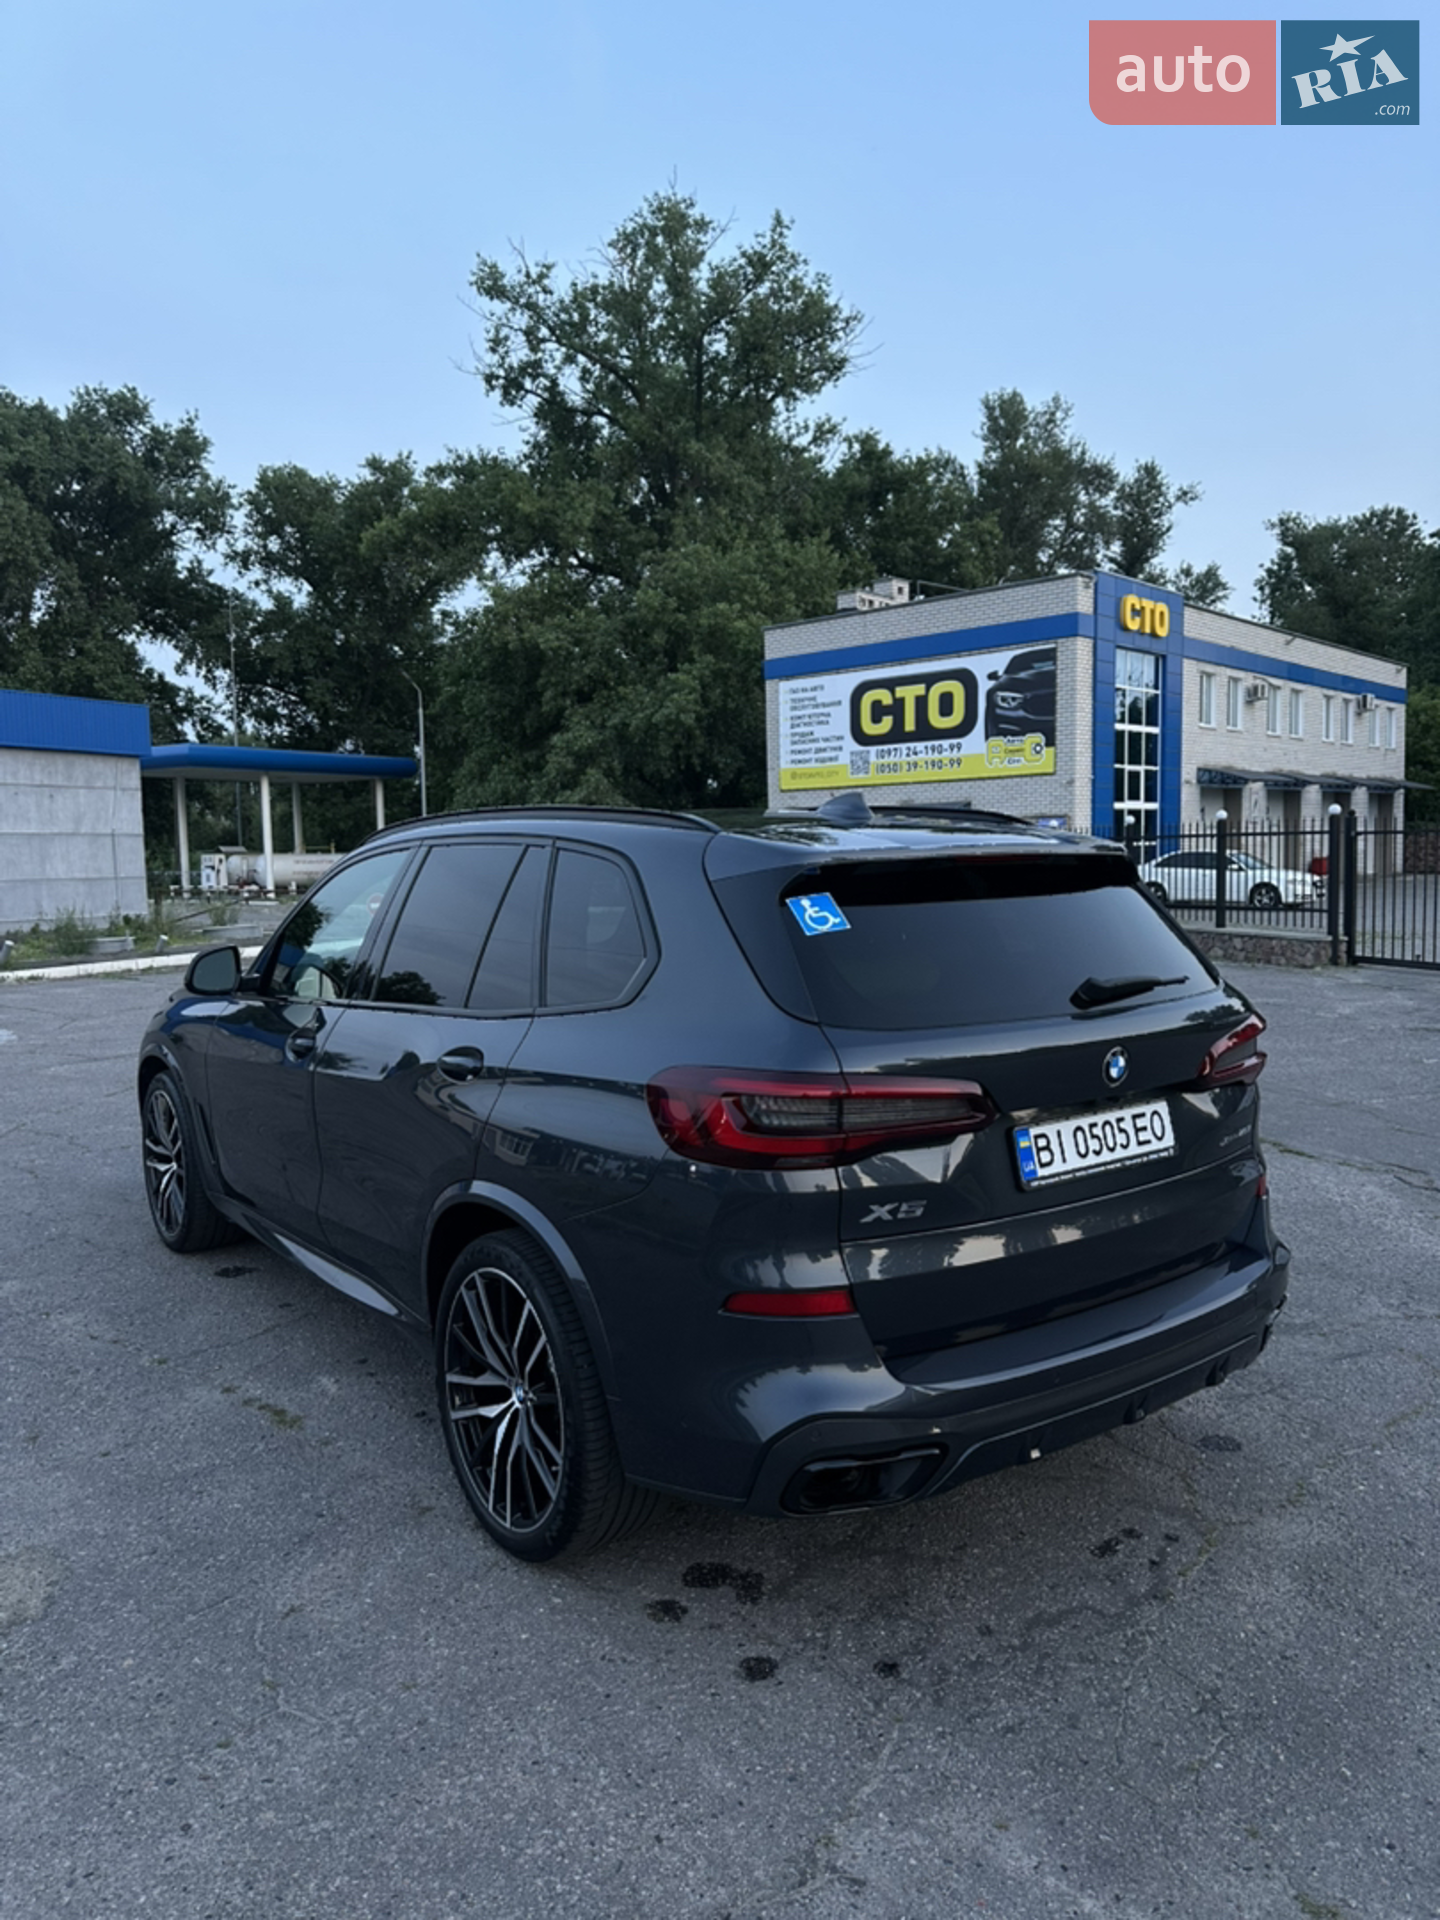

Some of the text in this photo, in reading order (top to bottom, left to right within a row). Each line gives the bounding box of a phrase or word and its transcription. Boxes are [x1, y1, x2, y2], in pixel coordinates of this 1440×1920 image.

[1119, 593, 1170, 638] СТО
[859, 679, 966, 737] СТО
[875, 741, 963, 760] (097) 24-190-99
[875, 757, 963, 775] (050) 39-190-99
[1033, 1129, 1067, 1168] BI
[1072, 1116, 1131, 1160] 0505
[1131, 1109, 1166, 1146] EO
[859, 1200, 927, 1224] X5
